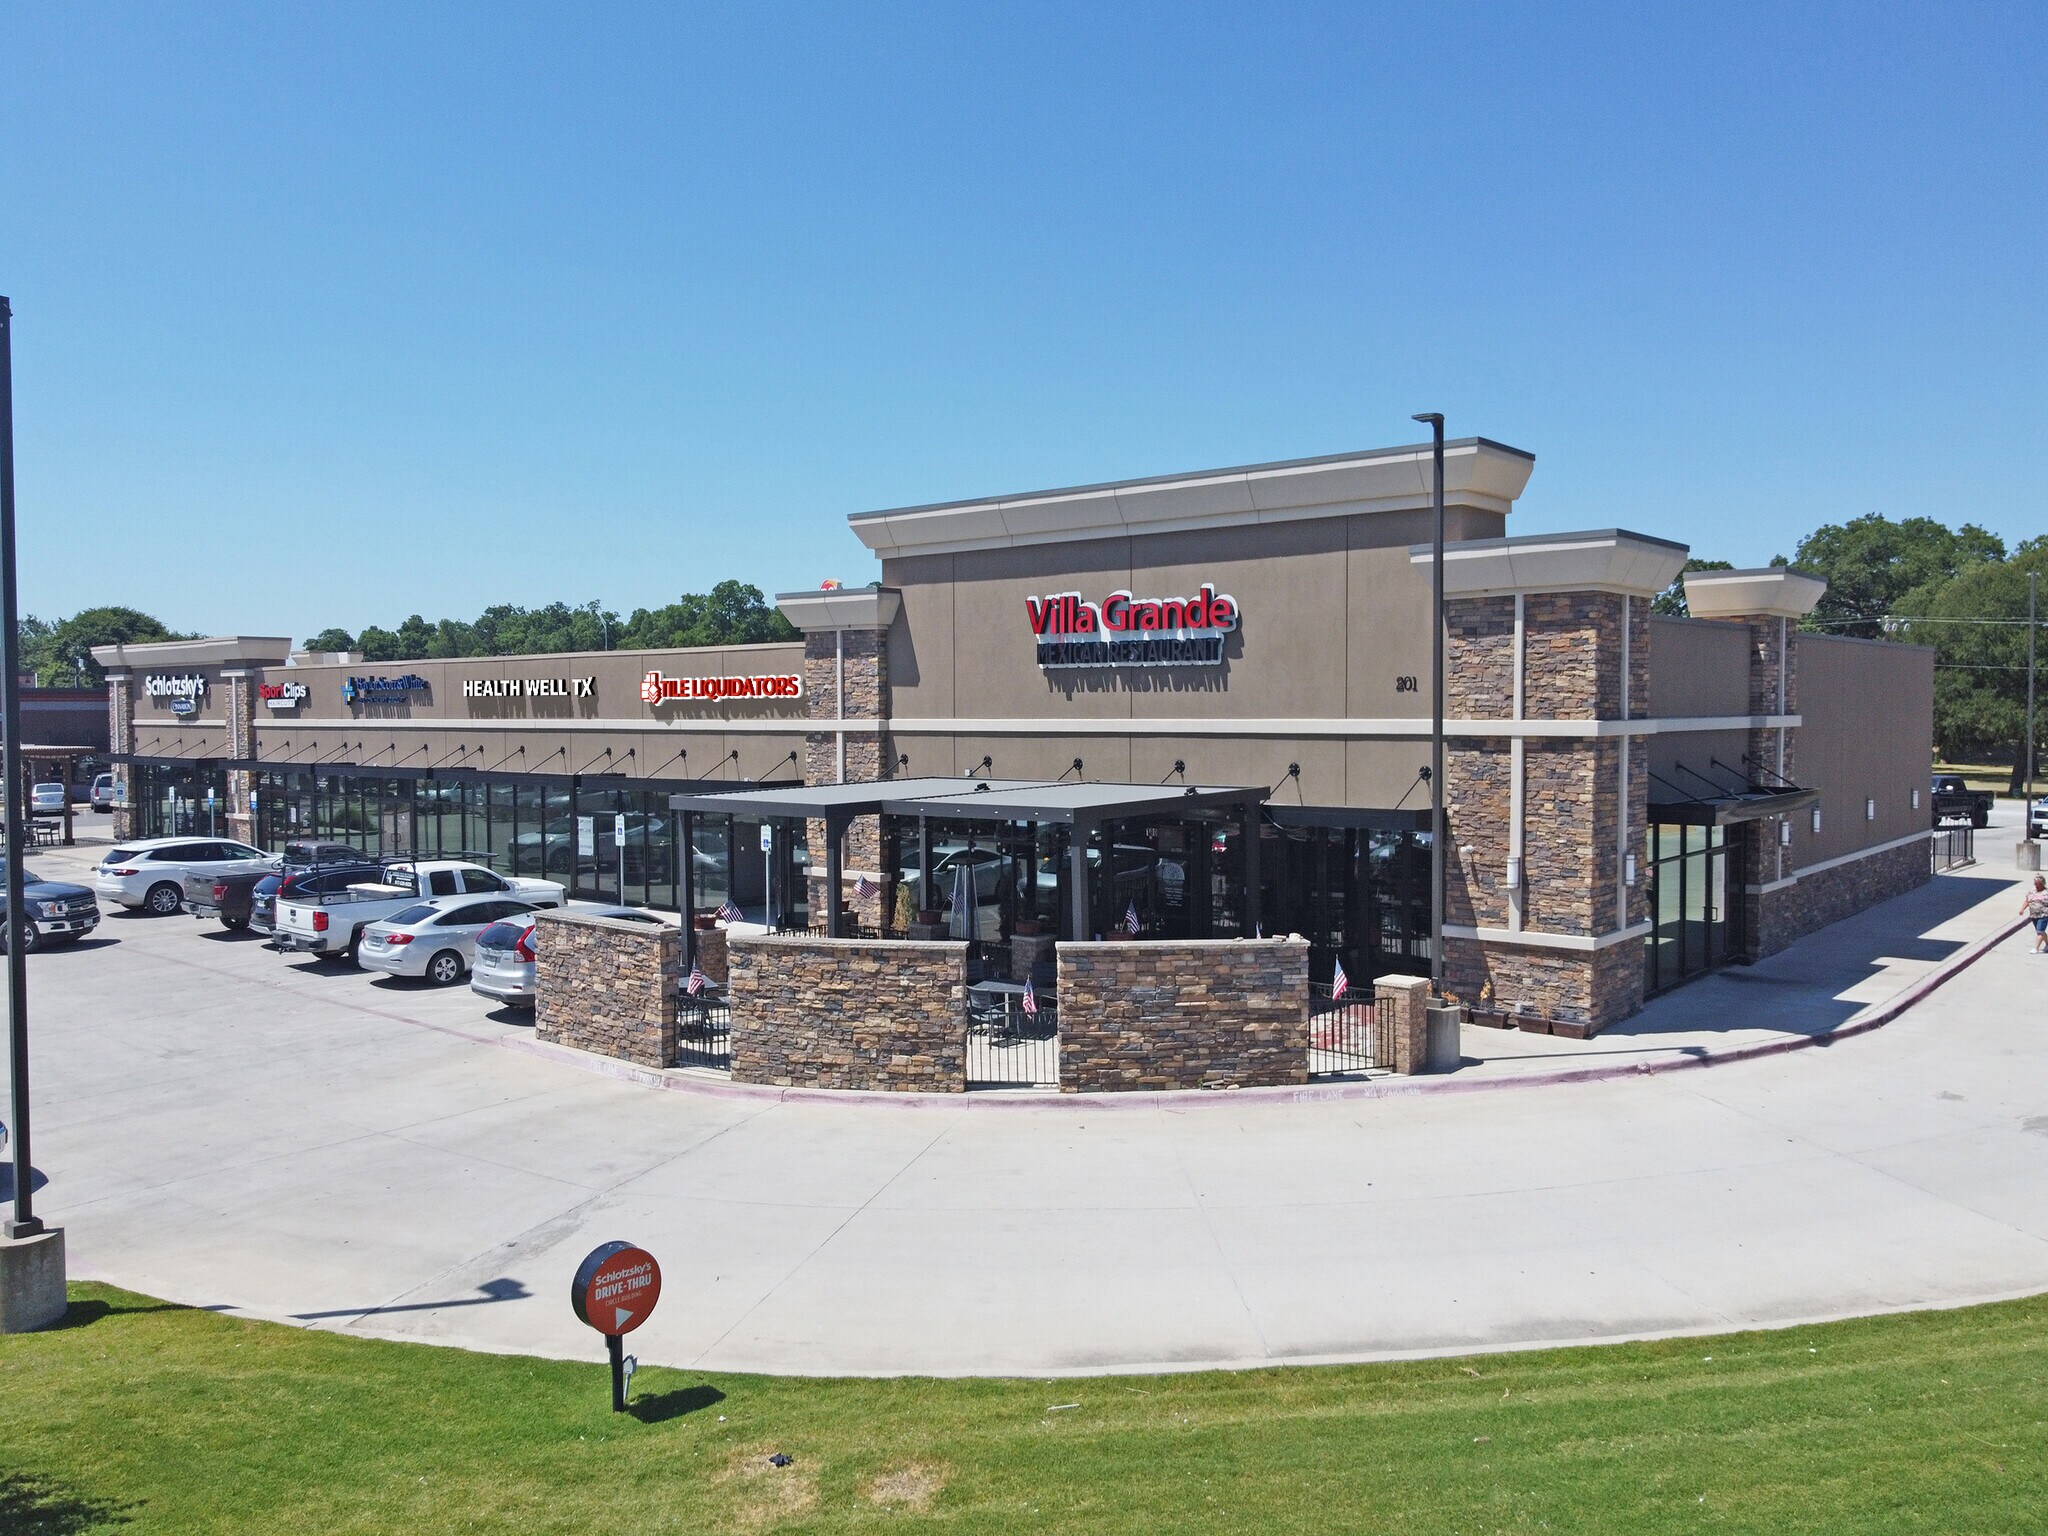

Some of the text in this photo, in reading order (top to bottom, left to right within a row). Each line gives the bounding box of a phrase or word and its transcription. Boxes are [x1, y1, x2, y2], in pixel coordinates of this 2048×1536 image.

[1025, 587, 1232, 635] Villa Grande
[1037, 637, 1221, 664] MEXICAN RESTAURANT
[145, 674, 204, 699] Schlotzsky's
[463, 677, 594, 698] HEALTH WELL TX
[660, 676, 799, 700] TILE LIQUIDATORS
[1396, 676, 1418, 692] 201
[595, 1261, 652, 1286] Schlotzsky's
[595, 1273, 652, 1301] DRIVE-THRU
